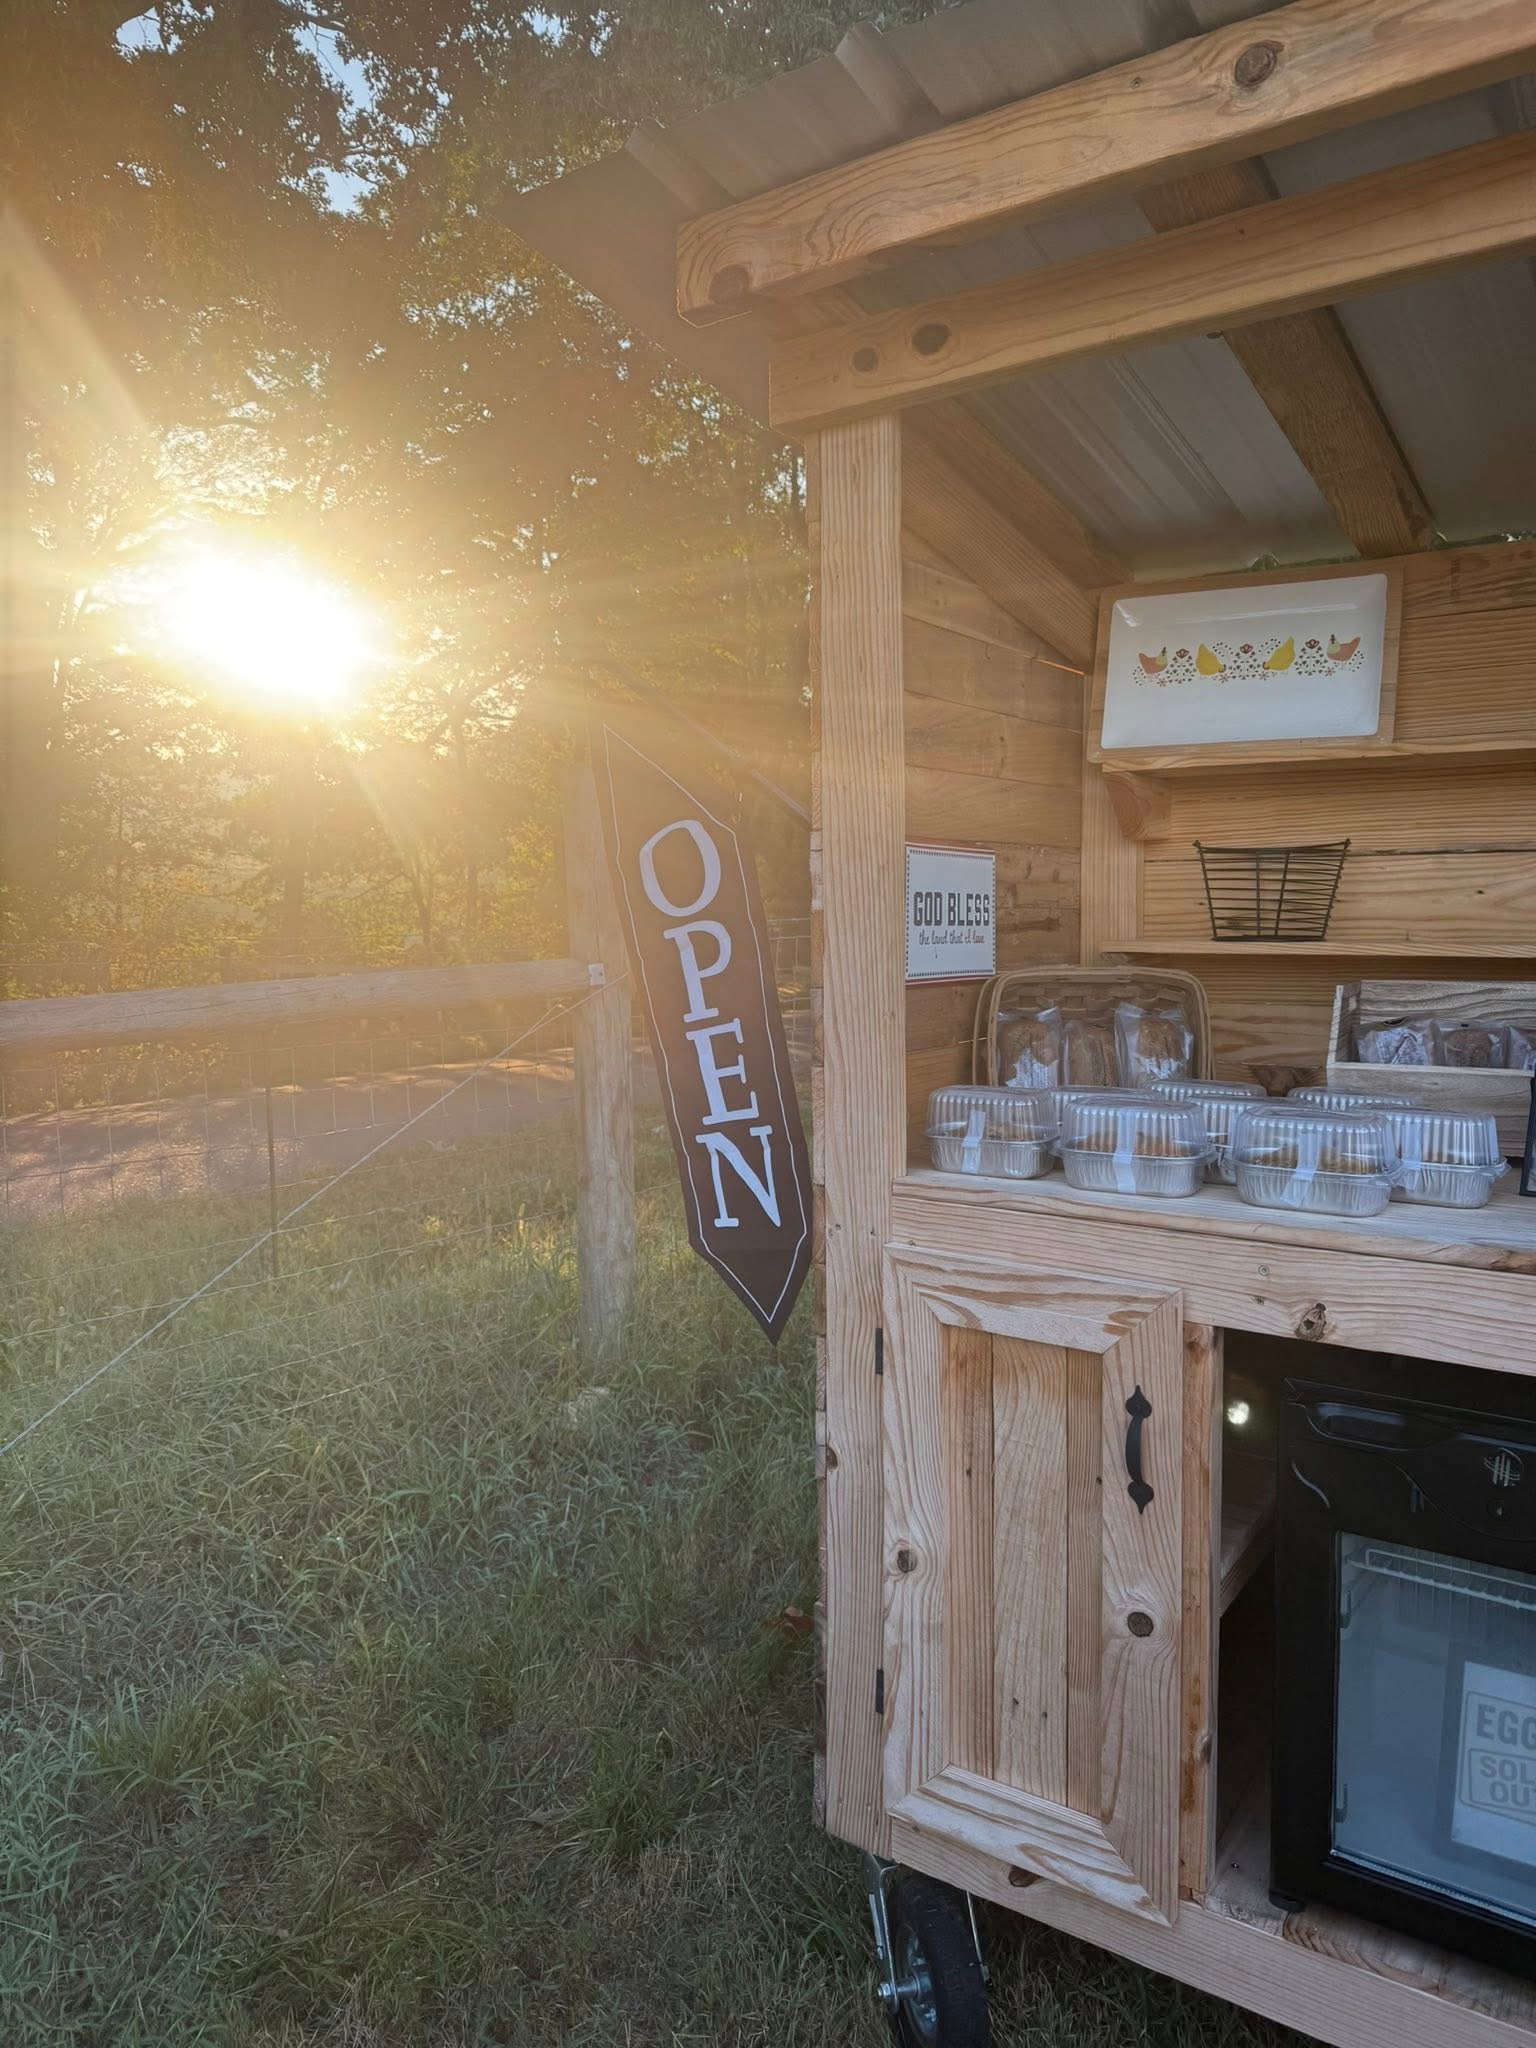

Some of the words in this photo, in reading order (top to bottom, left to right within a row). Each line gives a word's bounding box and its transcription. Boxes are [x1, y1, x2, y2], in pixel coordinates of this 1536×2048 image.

[914, 892, 942, 926] GOD
[948, 893, 990, 926] BLESS
[919, 930, 930, 945] the
[932, 930, 948, 944] land
[950, 930, 963, 944] that
[640, 819, 781, 1228] OPEN
[1489, 1780, 1536, 1807] OU
